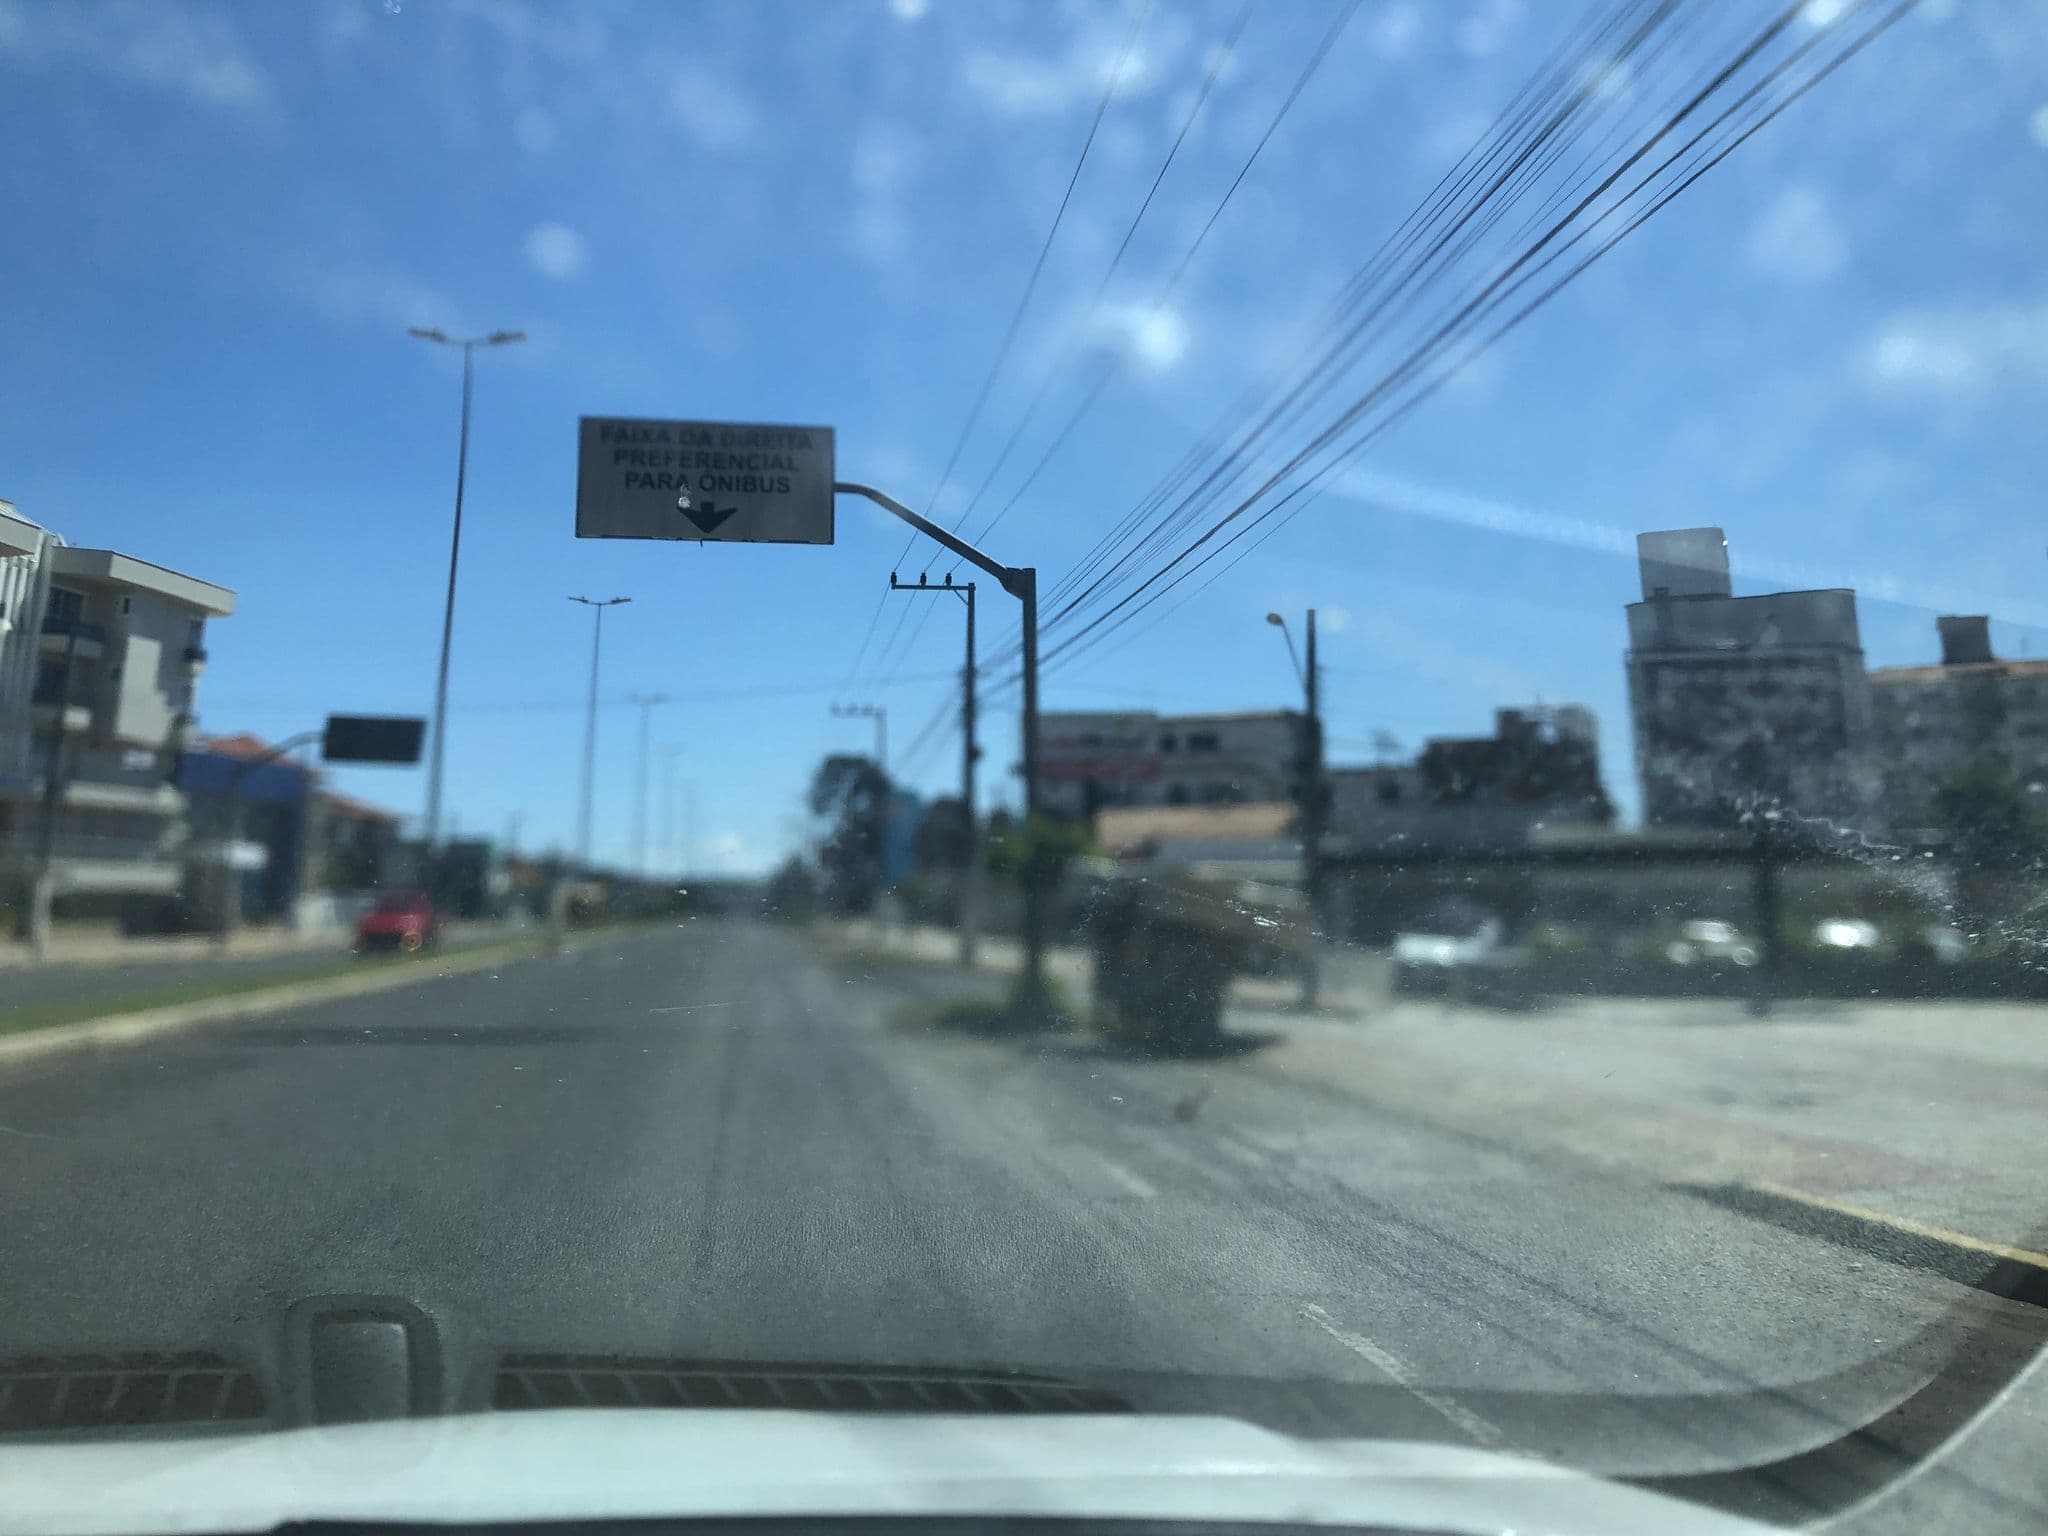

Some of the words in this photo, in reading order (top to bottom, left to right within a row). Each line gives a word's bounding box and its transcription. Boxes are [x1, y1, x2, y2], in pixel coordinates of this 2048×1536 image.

[679, 429, 713, 448] DA
[613, 449, 799, 472] PREFERENCIAL
[624, 472, 690, 490] PARA
